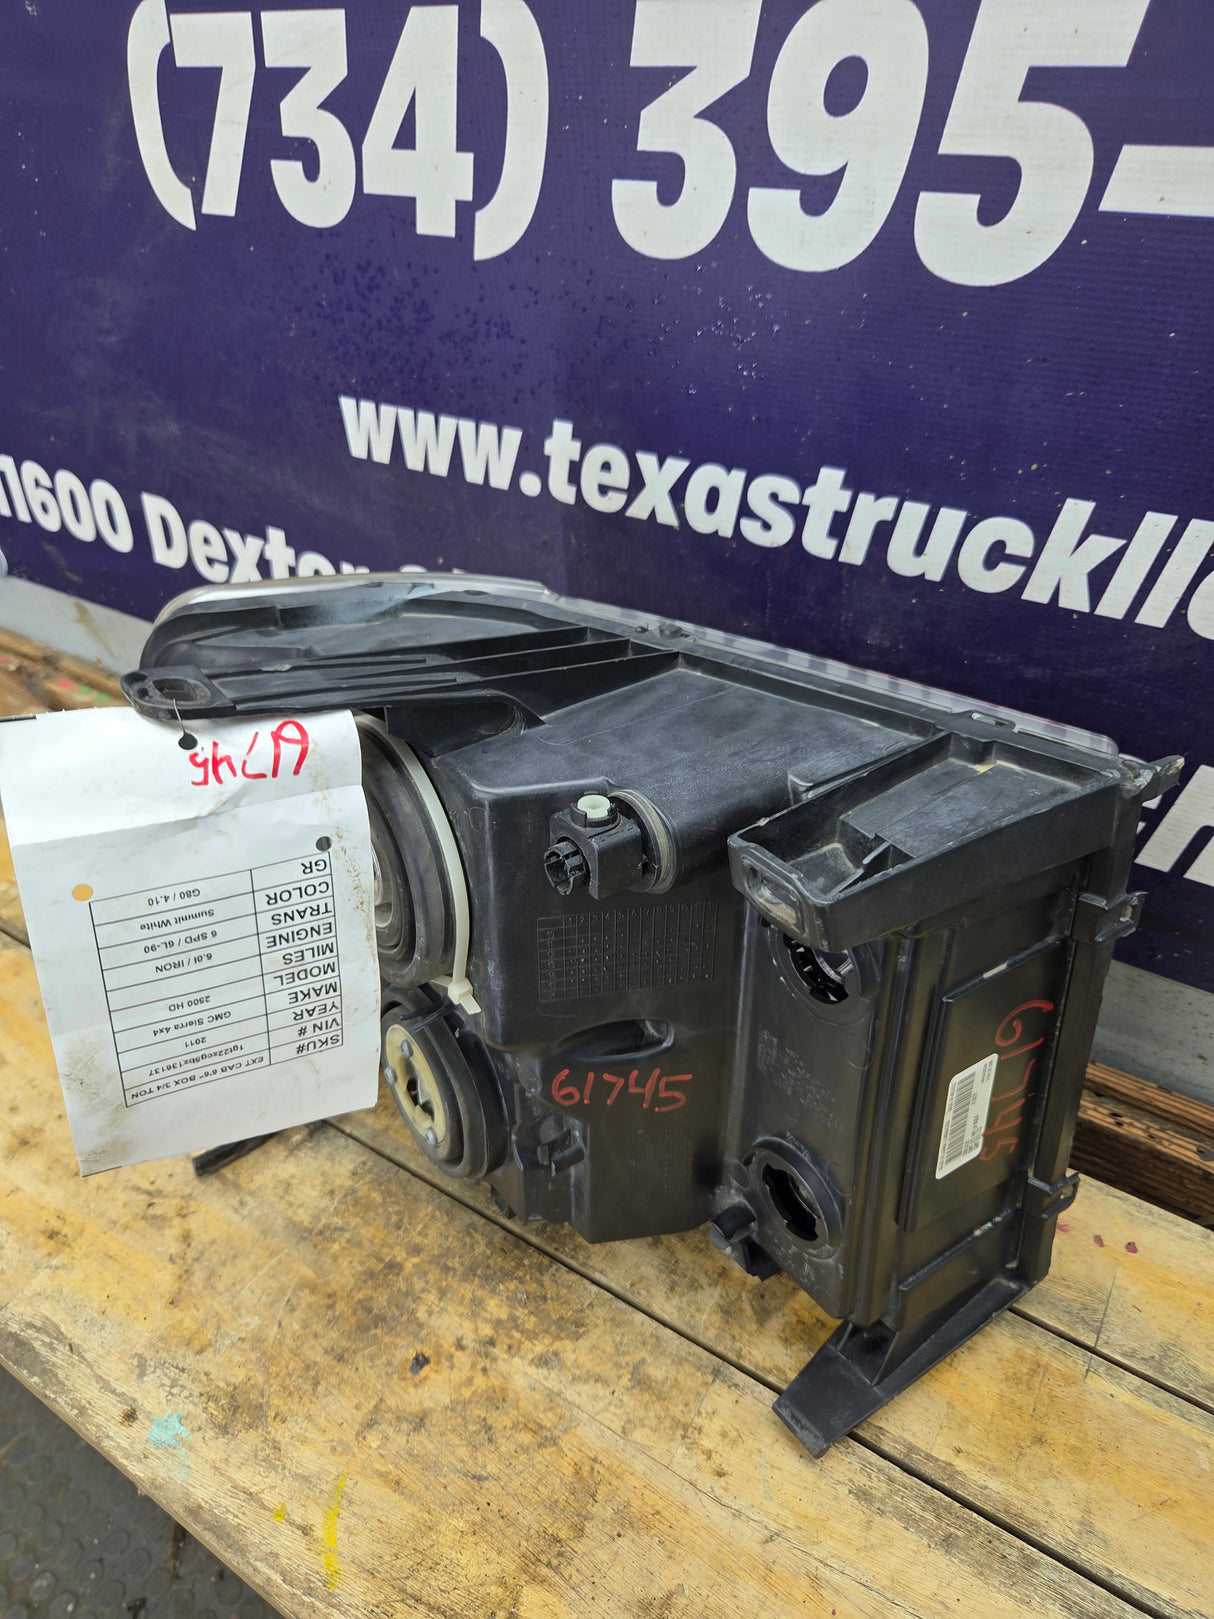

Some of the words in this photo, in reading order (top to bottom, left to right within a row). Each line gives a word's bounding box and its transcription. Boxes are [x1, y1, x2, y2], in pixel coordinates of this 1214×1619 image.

[127, 0, 549, 261] (734)
[141, 491, 370, 583] Dext
[300, 858, 327, 875] GR
[179, 887, 200, 899] G80
[265, 880, 330, 905] COLOR
[147, 894, 169, 906] 4.10
[173, 908, 215, 926] Summit
[270, 902, 331, 925] TRANS
[139, 920, 172, 932] White
[184, 931, 208, 944] SPD
[210, 930, 217, 938] 6
[265, 922, 332, 948] ENGINE
[143, 940, 174, 954] 6L-90
[282, 942, 334, 965] MILES
[154, 960, 184, 973] IRON
[273, 962, 335, 985] MODEL
[288, 982, 338, 1004] MAKE
[168, 1002, 184, 1012] HD
[187, 995, 211, 1007] 2500
[207, 1010, 231, 1023] GMC
[292, 1001, 339, 1020] YEAR
[173, 1017, 204, 1031] Sierra
[312, 1018, 339, 1033] VIN
[152, 1026, 171, 1037] 4x4
[297, 1026, 308, 1036] #
[184, 1036, 207, 1048] 2011
[296, 1034, 340, 1054] SKU#
[220, 1062, 242, 1073] CAB
[245, 1056, 264, 1067] EXT
[155, 1082, 171, 1092] 3/4
[173, 1075, 196, 1086] BOX
[130, 1086, 154, 1099] TON
[551, 1068, 693, 1113] 61745
